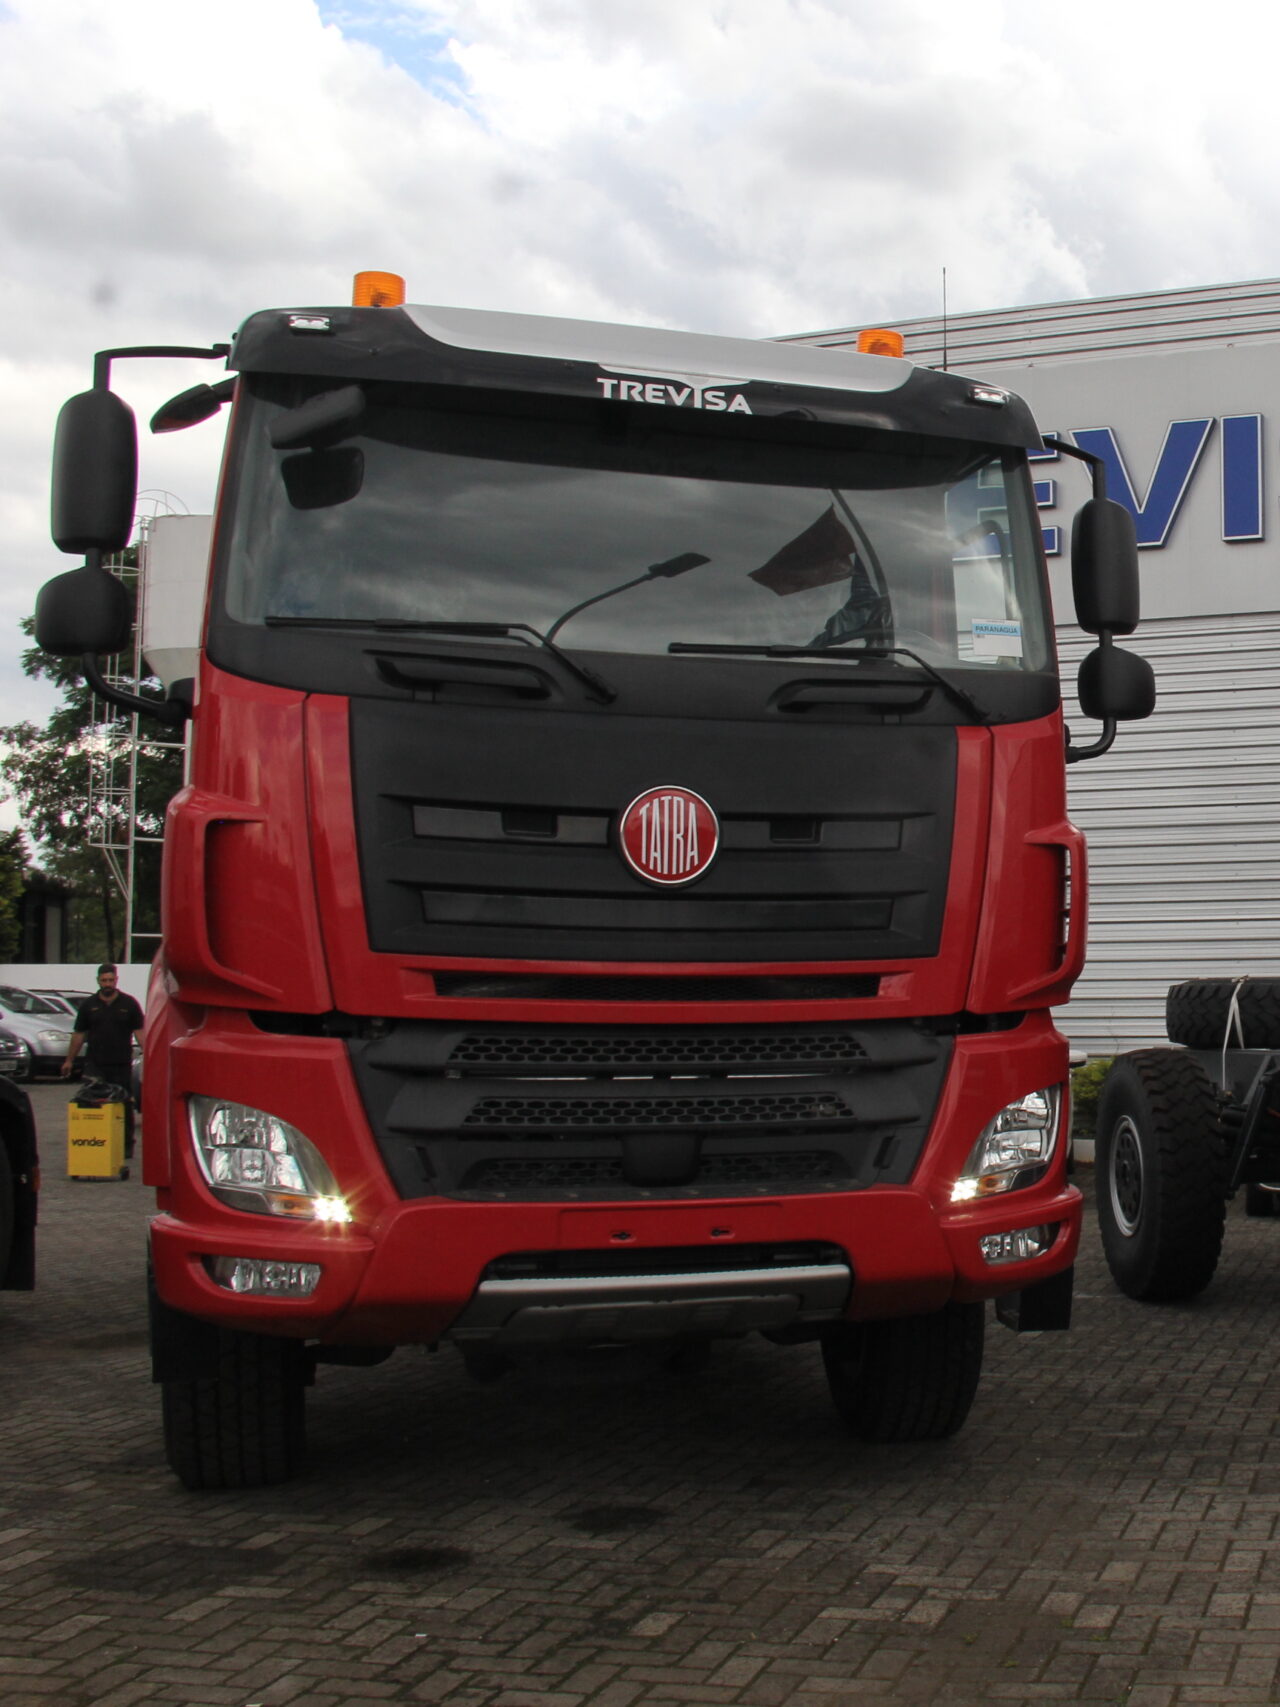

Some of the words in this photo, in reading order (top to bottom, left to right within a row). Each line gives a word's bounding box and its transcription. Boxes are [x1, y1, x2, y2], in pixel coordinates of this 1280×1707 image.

[596, 377, 753, 415] TREVISA
[639, 795, 699, 875] TATRA
[71, 1136, 106, 1147] vonder
